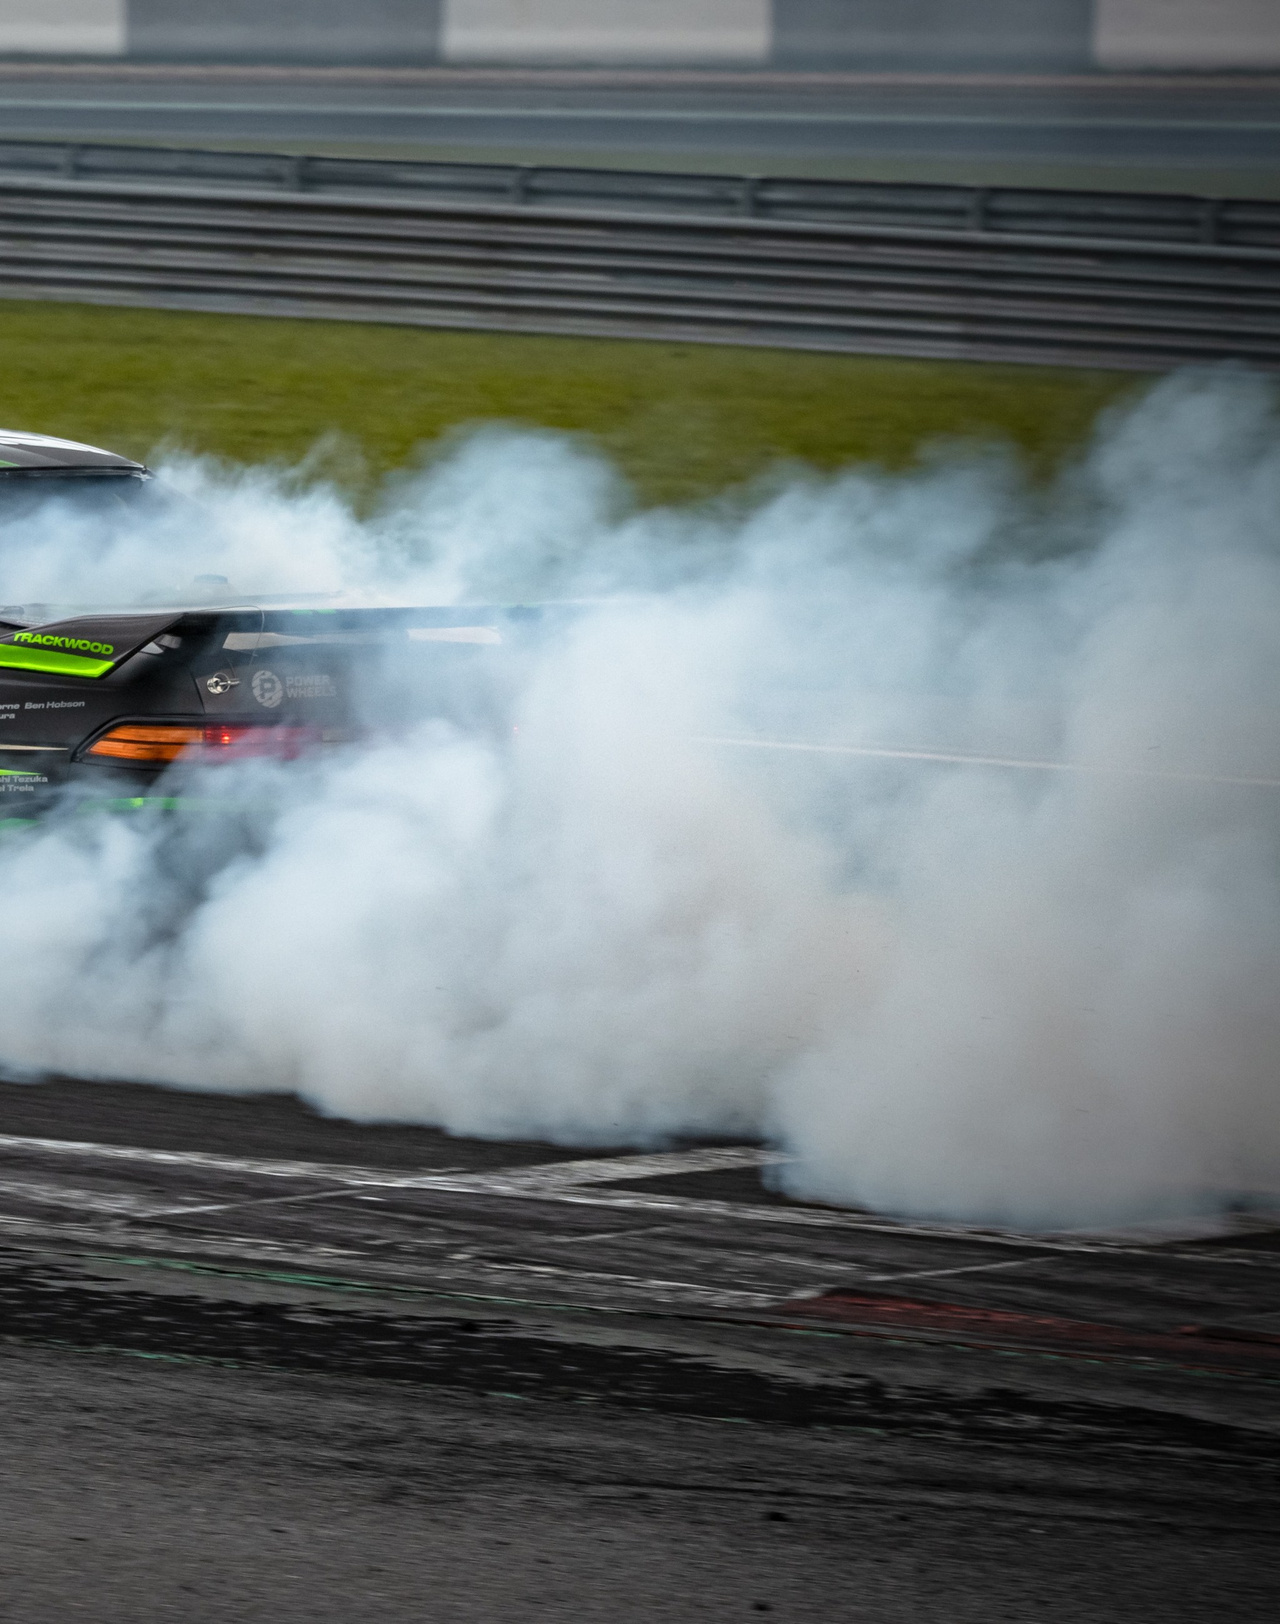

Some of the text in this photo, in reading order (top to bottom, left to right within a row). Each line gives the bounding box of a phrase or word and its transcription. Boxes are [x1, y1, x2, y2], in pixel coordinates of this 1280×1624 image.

[13, 632, 114, 655] TRACKWOOD
[286, 674, 331, 688] POWER
[286, 686, 338, 699] WHEELS
[24, 701, 46, 710] Ben
[46, 699, 86, 709] Hobson
[12, 775, 49, 784] Tezuka
[7, 784, 35, 793] Trela
